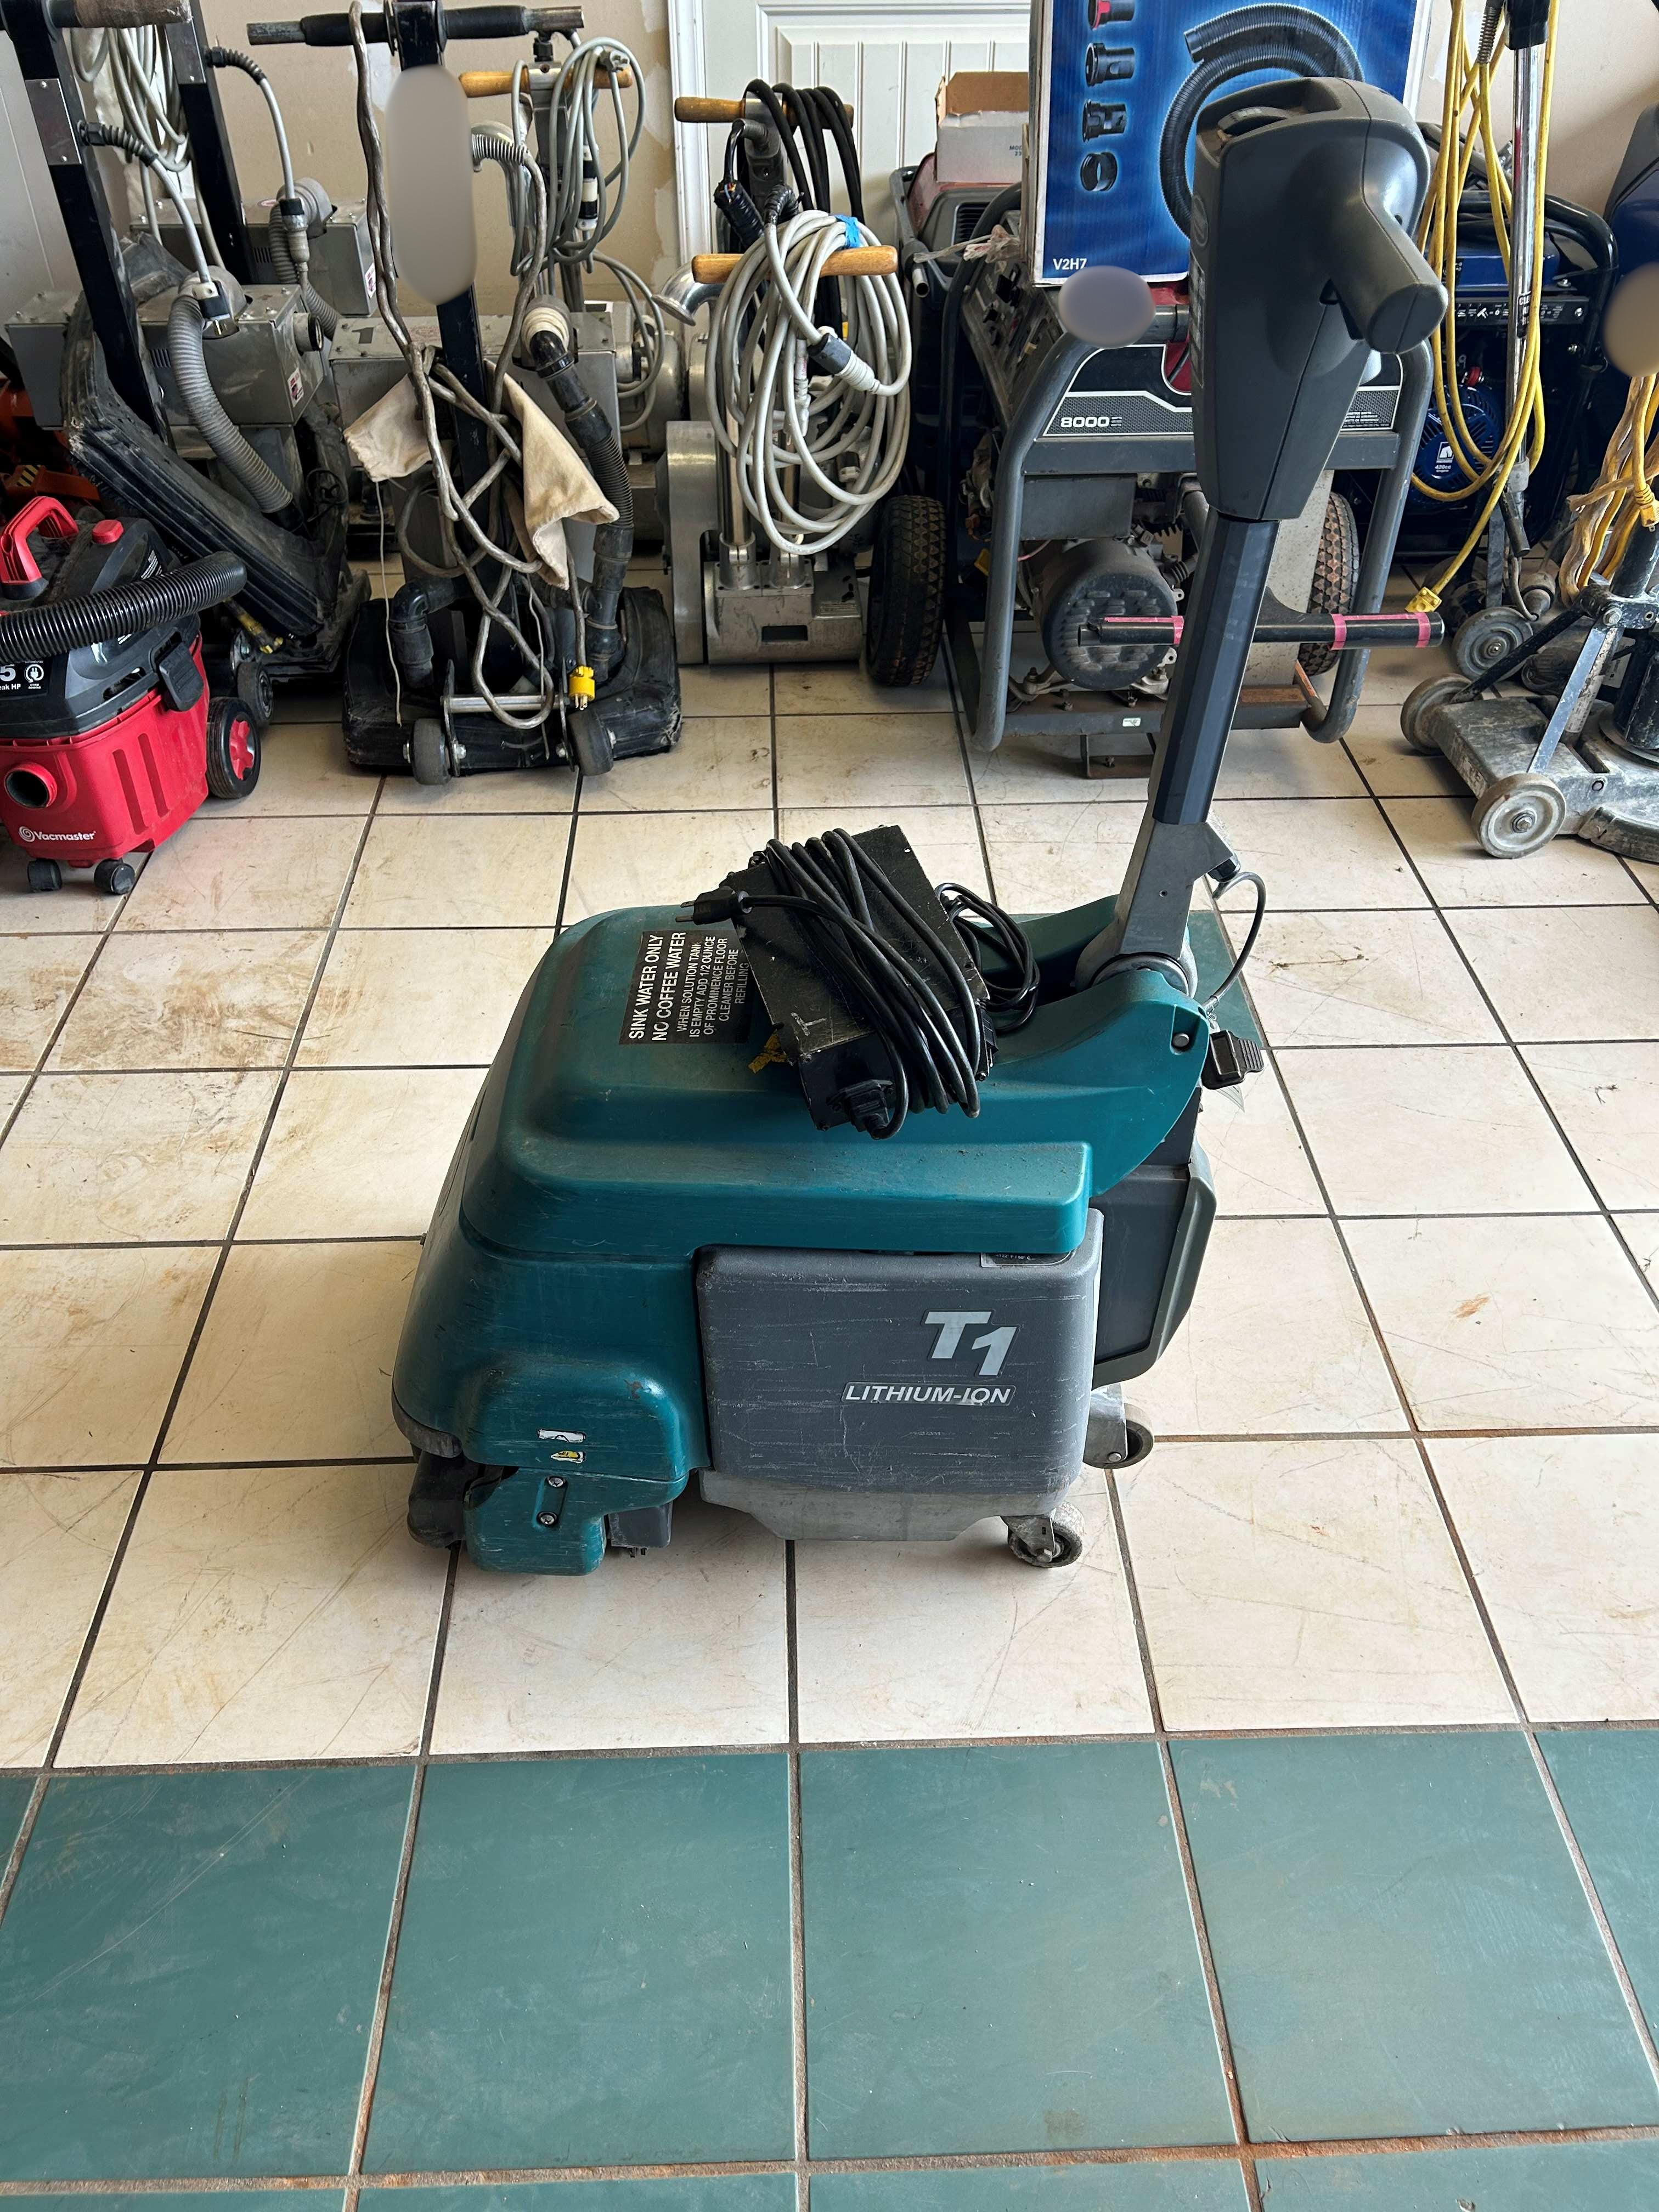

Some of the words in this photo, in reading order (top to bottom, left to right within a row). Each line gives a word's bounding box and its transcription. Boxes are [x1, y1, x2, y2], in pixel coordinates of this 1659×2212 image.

[1053, 258, 1087, 270] V2H7
[1060, 416, 1110, 427] 8000
[33, 831, 95, 840] Vacmaster
[645, 934, 663, 963] ONLY
[665, 932, 686, 969] WATER
[689, 942, 702, 961] TANK
[702, 936, 715, 963] OUNCE
[714, 938, 728, 964] FLOOR
[701, 964, 710, 975] 1/2
[725, 949, 739, 980] BEFORE
[635, 966, 657, 1006] WATER
[656, 972, 678, 1018] COFFEE
[682, 963, 698, 1003] SOLUTION
[696, 978, 708, 996] ADD
[706, 965, 724, 1020] PROMINENCE
[735, 962, 749, 1004] REFILLING
[691, 997, 705, 1027] EMPTY
[719, 982, 734, 1022] CLEANER
[629, 1008, 649, 1039] SINK
[652, 1022, 669, 1041] NO
[676, 1006, 690, 1032] WHEN
[703, 1023, 714, 1035] OF
[689, 1029, 701, 1037] IS
[925, 1311, 1017, 1375] T1
[845, 1385, 1011, 1403] LITHIUM-ION
